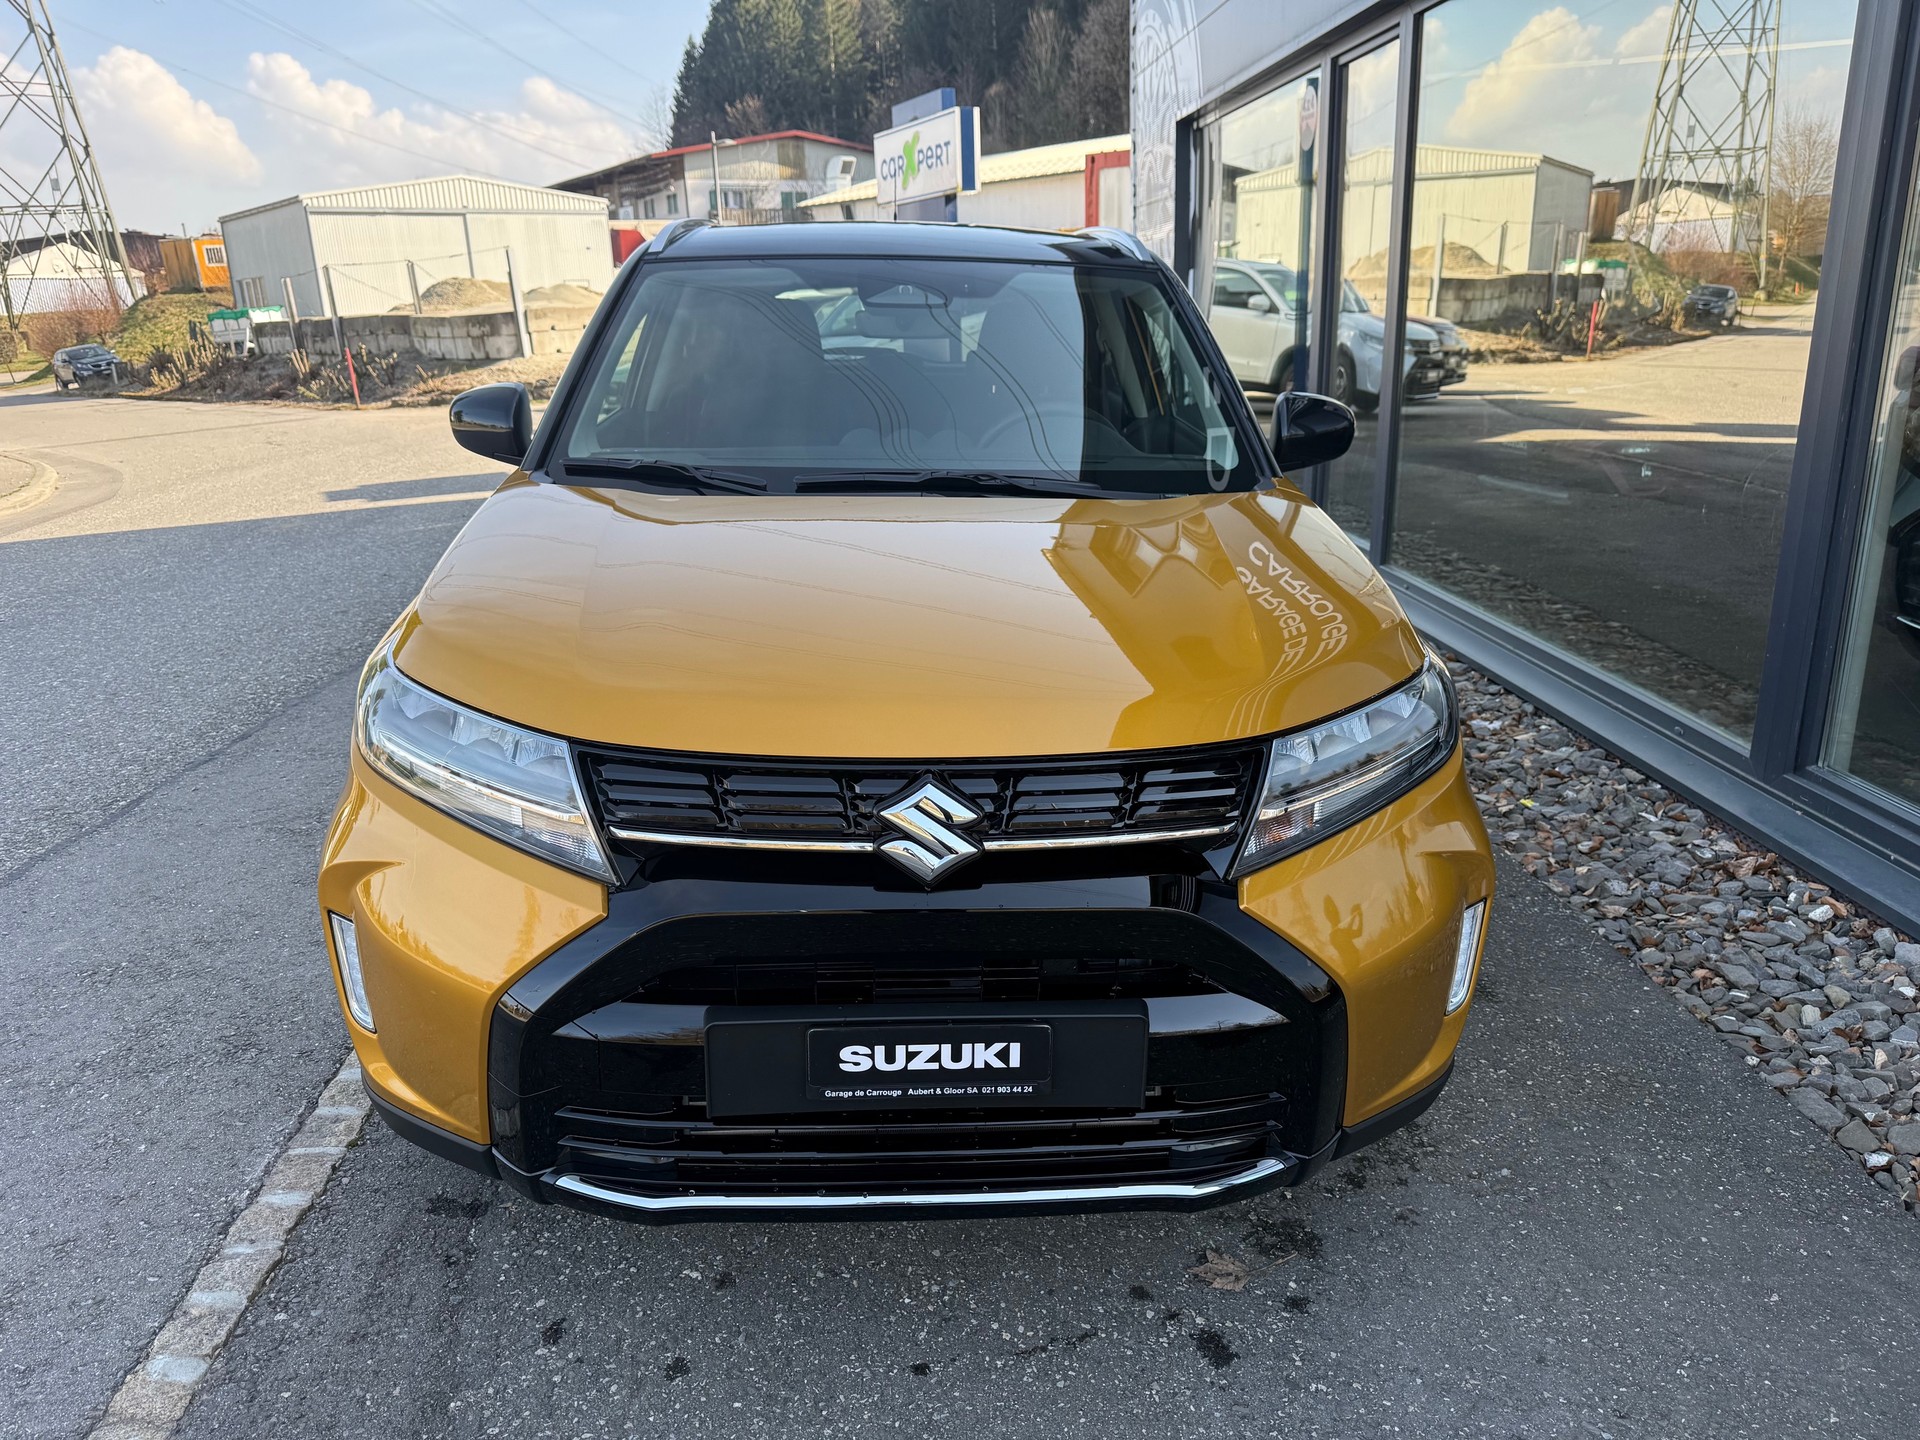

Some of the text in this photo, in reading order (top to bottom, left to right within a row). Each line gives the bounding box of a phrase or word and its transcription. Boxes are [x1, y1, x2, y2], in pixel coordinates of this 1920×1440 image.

[838, 1042, 1021, 1073] SUZUKI
[824, 1085, 1033, 1099] Garage de Carrouge Aubert & Gloor SA 021 903 44 24
